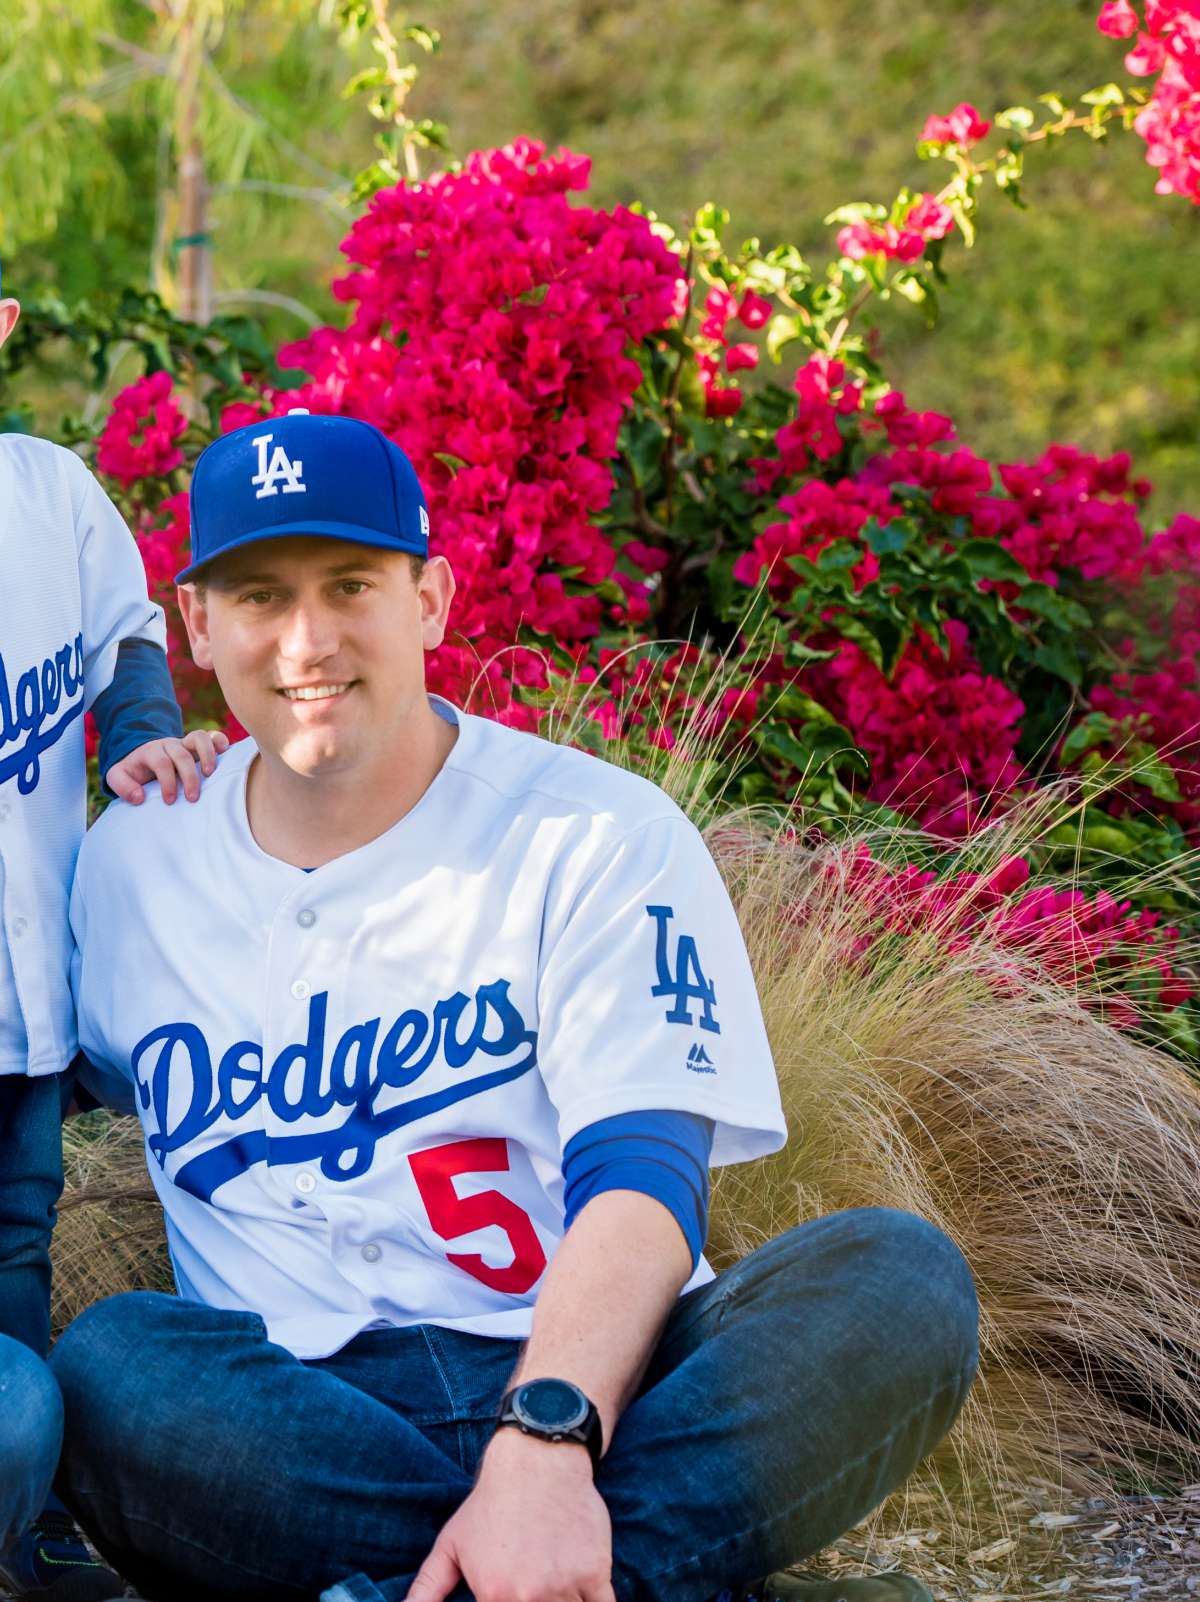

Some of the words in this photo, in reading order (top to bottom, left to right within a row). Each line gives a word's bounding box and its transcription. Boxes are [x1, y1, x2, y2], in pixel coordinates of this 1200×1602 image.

[252, 434, 306, 499] LA
[646, 905, 721, 1035] LA
[131, 978, 537, 1204] Dodgers
[408, 1137, 547, 1294] 5
